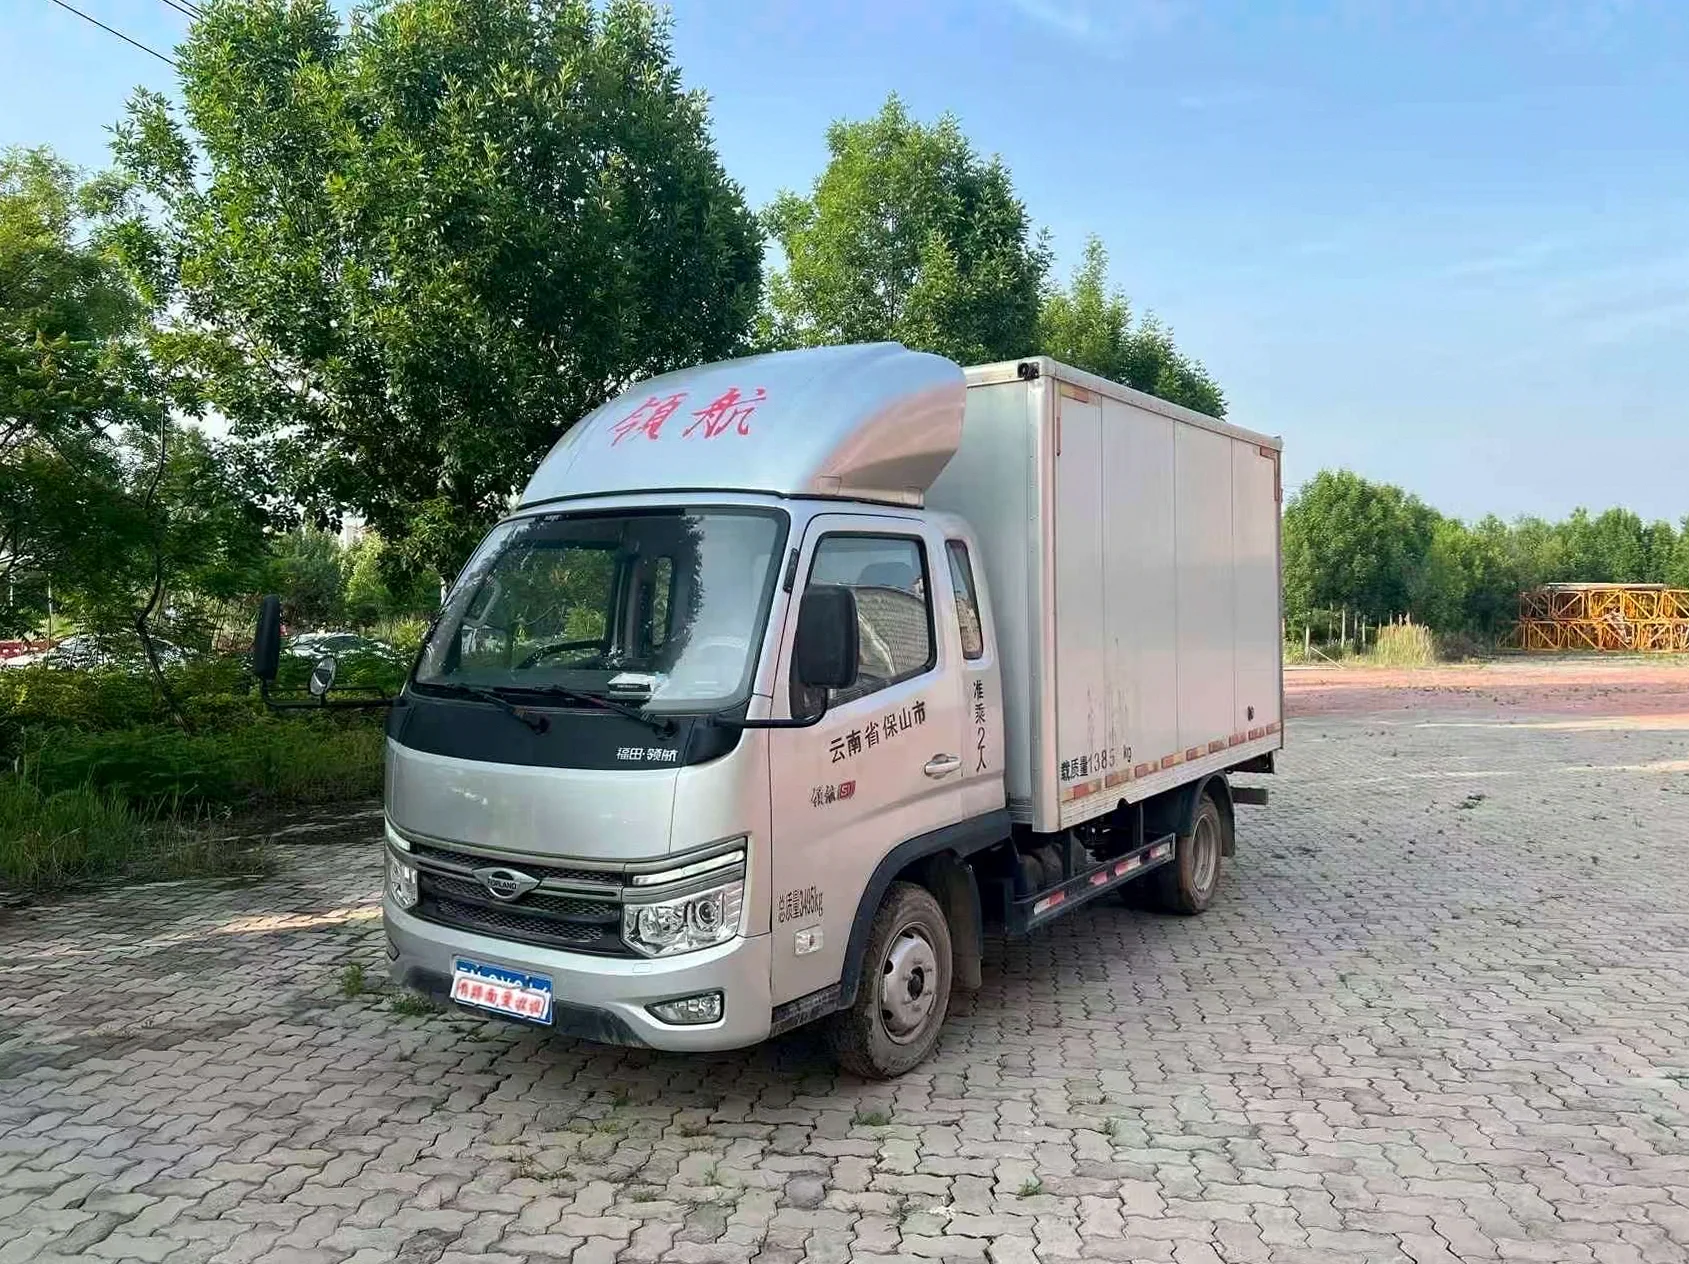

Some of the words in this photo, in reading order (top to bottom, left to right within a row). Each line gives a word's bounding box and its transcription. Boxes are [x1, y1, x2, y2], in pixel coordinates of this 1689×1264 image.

[607, 387, 766, 447] 领航
[829, 700, 926, 763] 云南省保山市
[973, 680, 987, 773] 准乘2人
